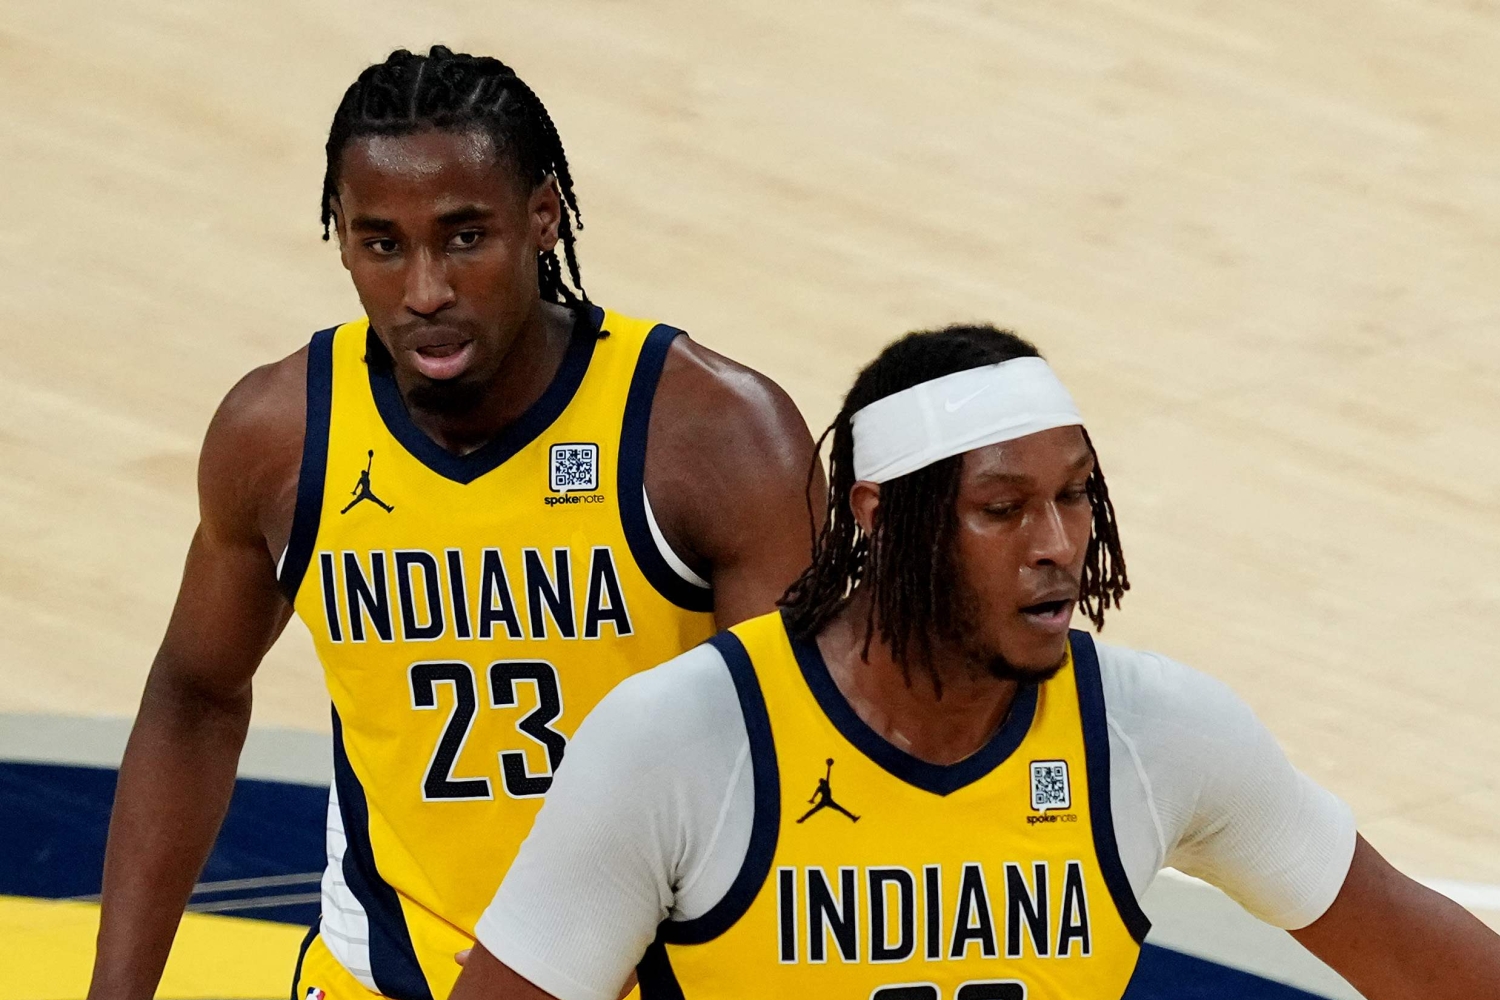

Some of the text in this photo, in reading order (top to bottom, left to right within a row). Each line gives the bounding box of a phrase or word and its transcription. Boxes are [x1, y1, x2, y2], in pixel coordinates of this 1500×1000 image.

[544, 493, 605, 507] spokenote
[318, 545, 635, 643] INDIANA
[407, 658, 570, 802] 23
[1026, 810, 1078, 827] spokenote
[776, 860, 1092, 964] INDIANA
